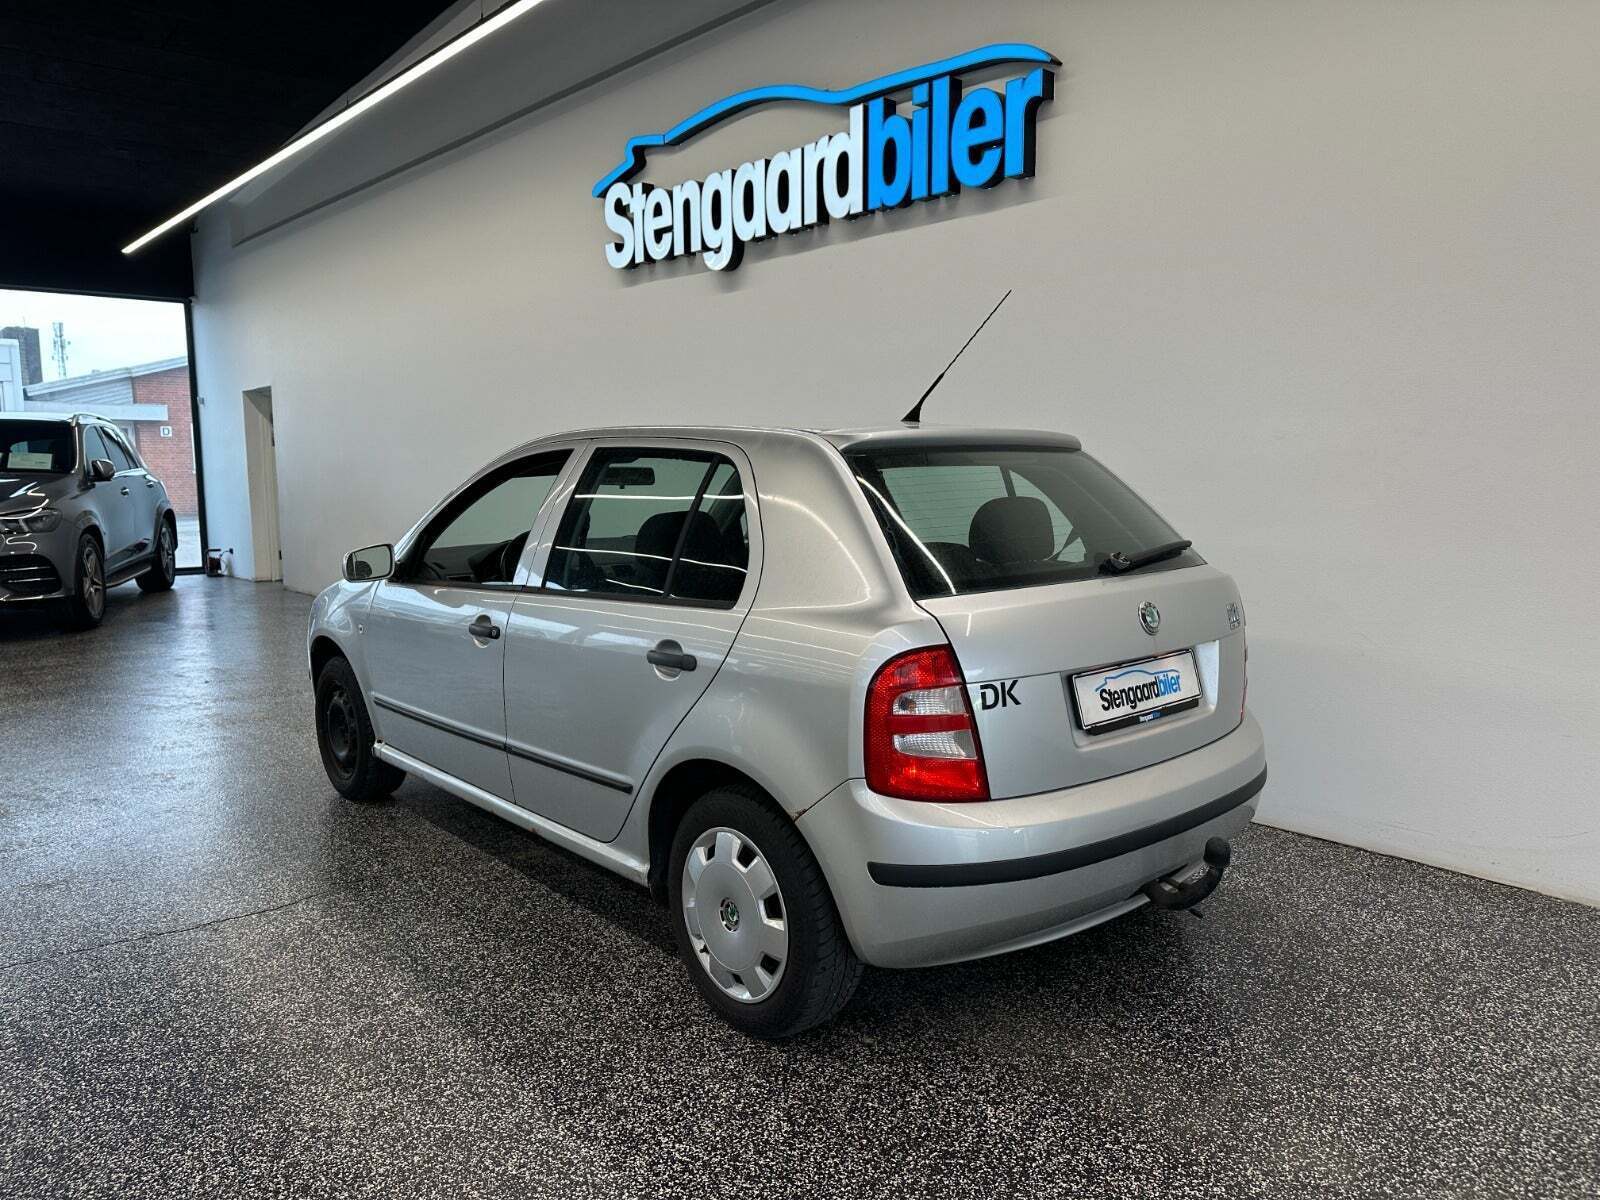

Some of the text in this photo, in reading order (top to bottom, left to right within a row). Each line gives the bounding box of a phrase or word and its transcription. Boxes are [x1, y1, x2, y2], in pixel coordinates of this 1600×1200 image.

[604, 68, 1050, 271] Stengaardbiler
[979, 679, 1022, 711] DK
[1099, 674, 1181, 711] Stengaardbiler
